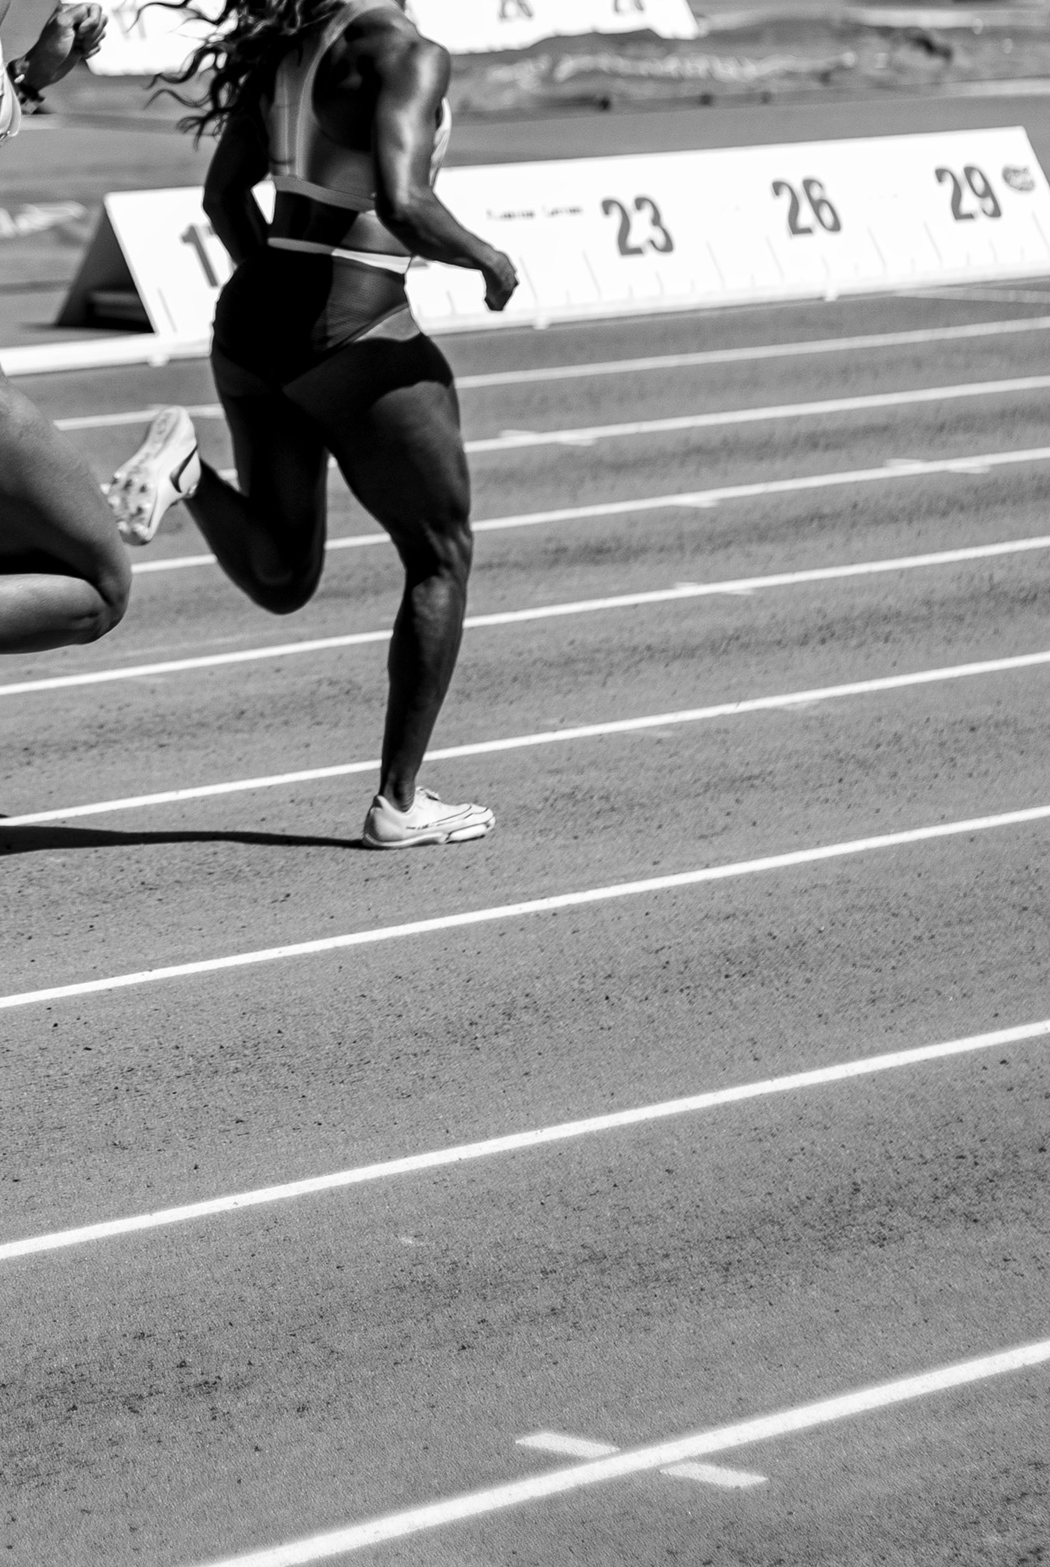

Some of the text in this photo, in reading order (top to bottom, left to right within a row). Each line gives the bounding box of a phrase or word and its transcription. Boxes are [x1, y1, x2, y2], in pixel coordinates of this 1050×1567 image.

[601, 196, 675, 256] 23
[771, 178, 842, 236] 26
[934, 165, 1002, 221] 29
